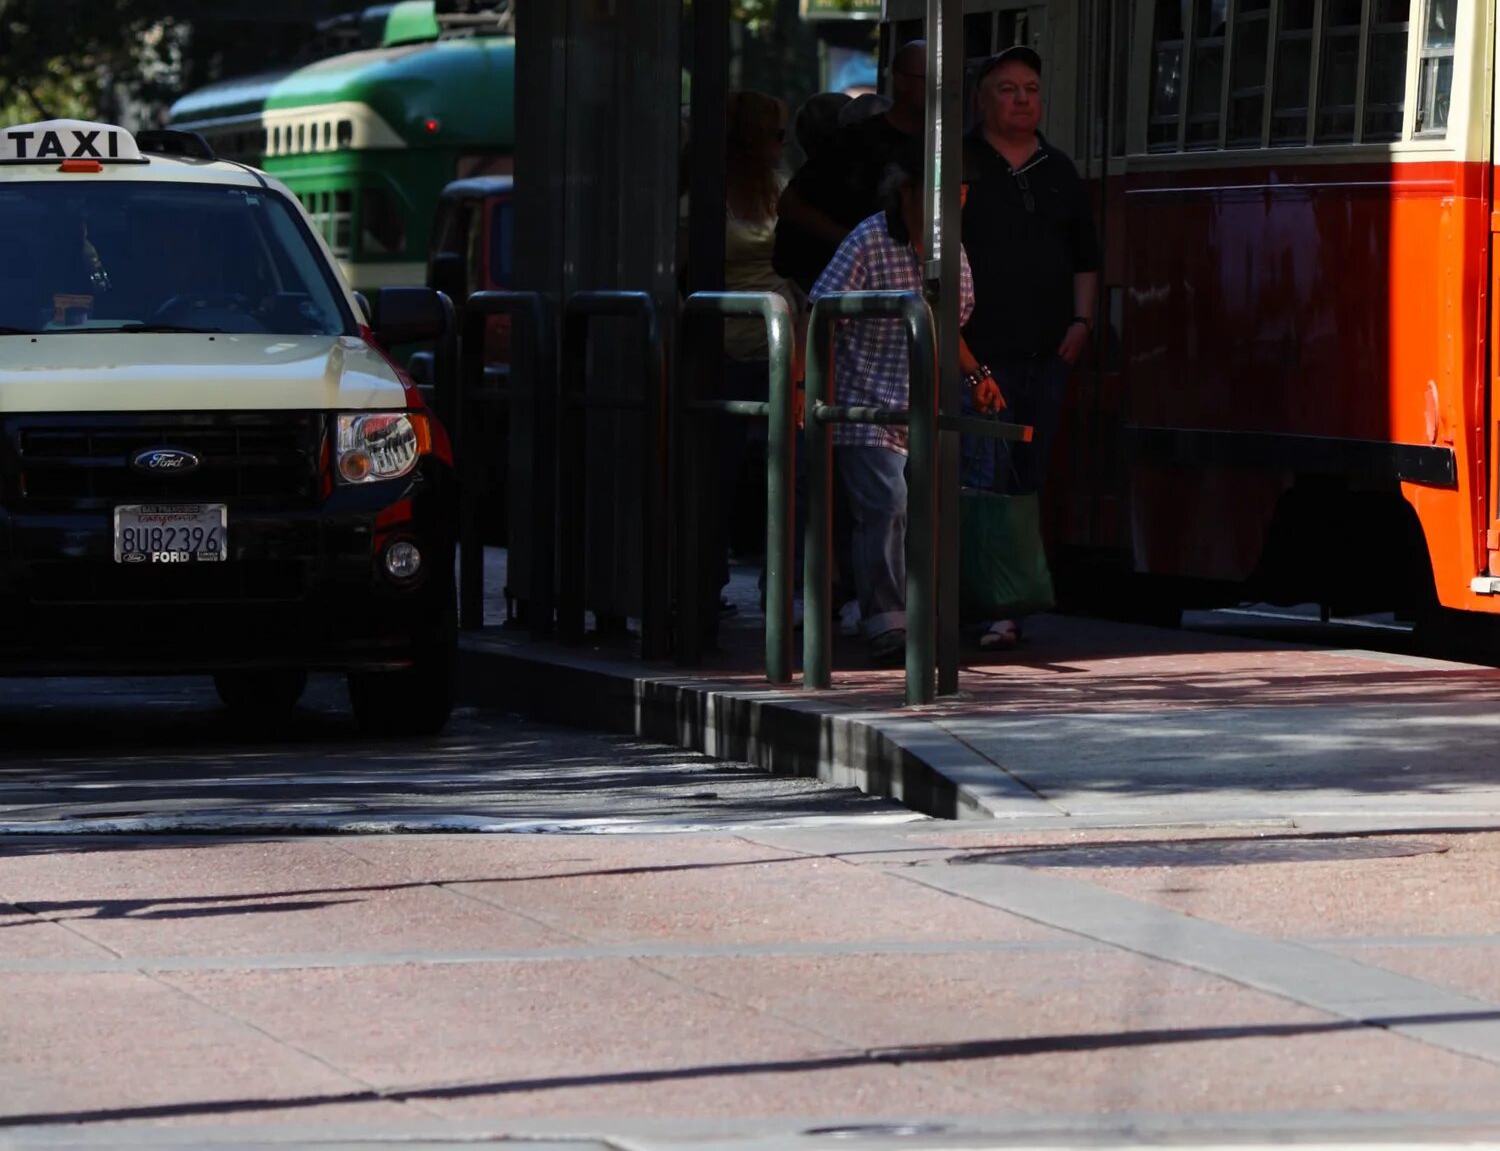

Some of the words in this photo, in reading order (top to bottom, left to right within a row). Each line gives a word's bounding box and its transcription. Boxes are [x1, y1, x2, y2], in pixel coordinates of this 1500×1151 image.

[8, 131, 118, 158] TAXI
[149, 454, 184, 467] Ford
[123, 527, 219, 553] 8U82396
[152, 552, 190, 563] FORD
